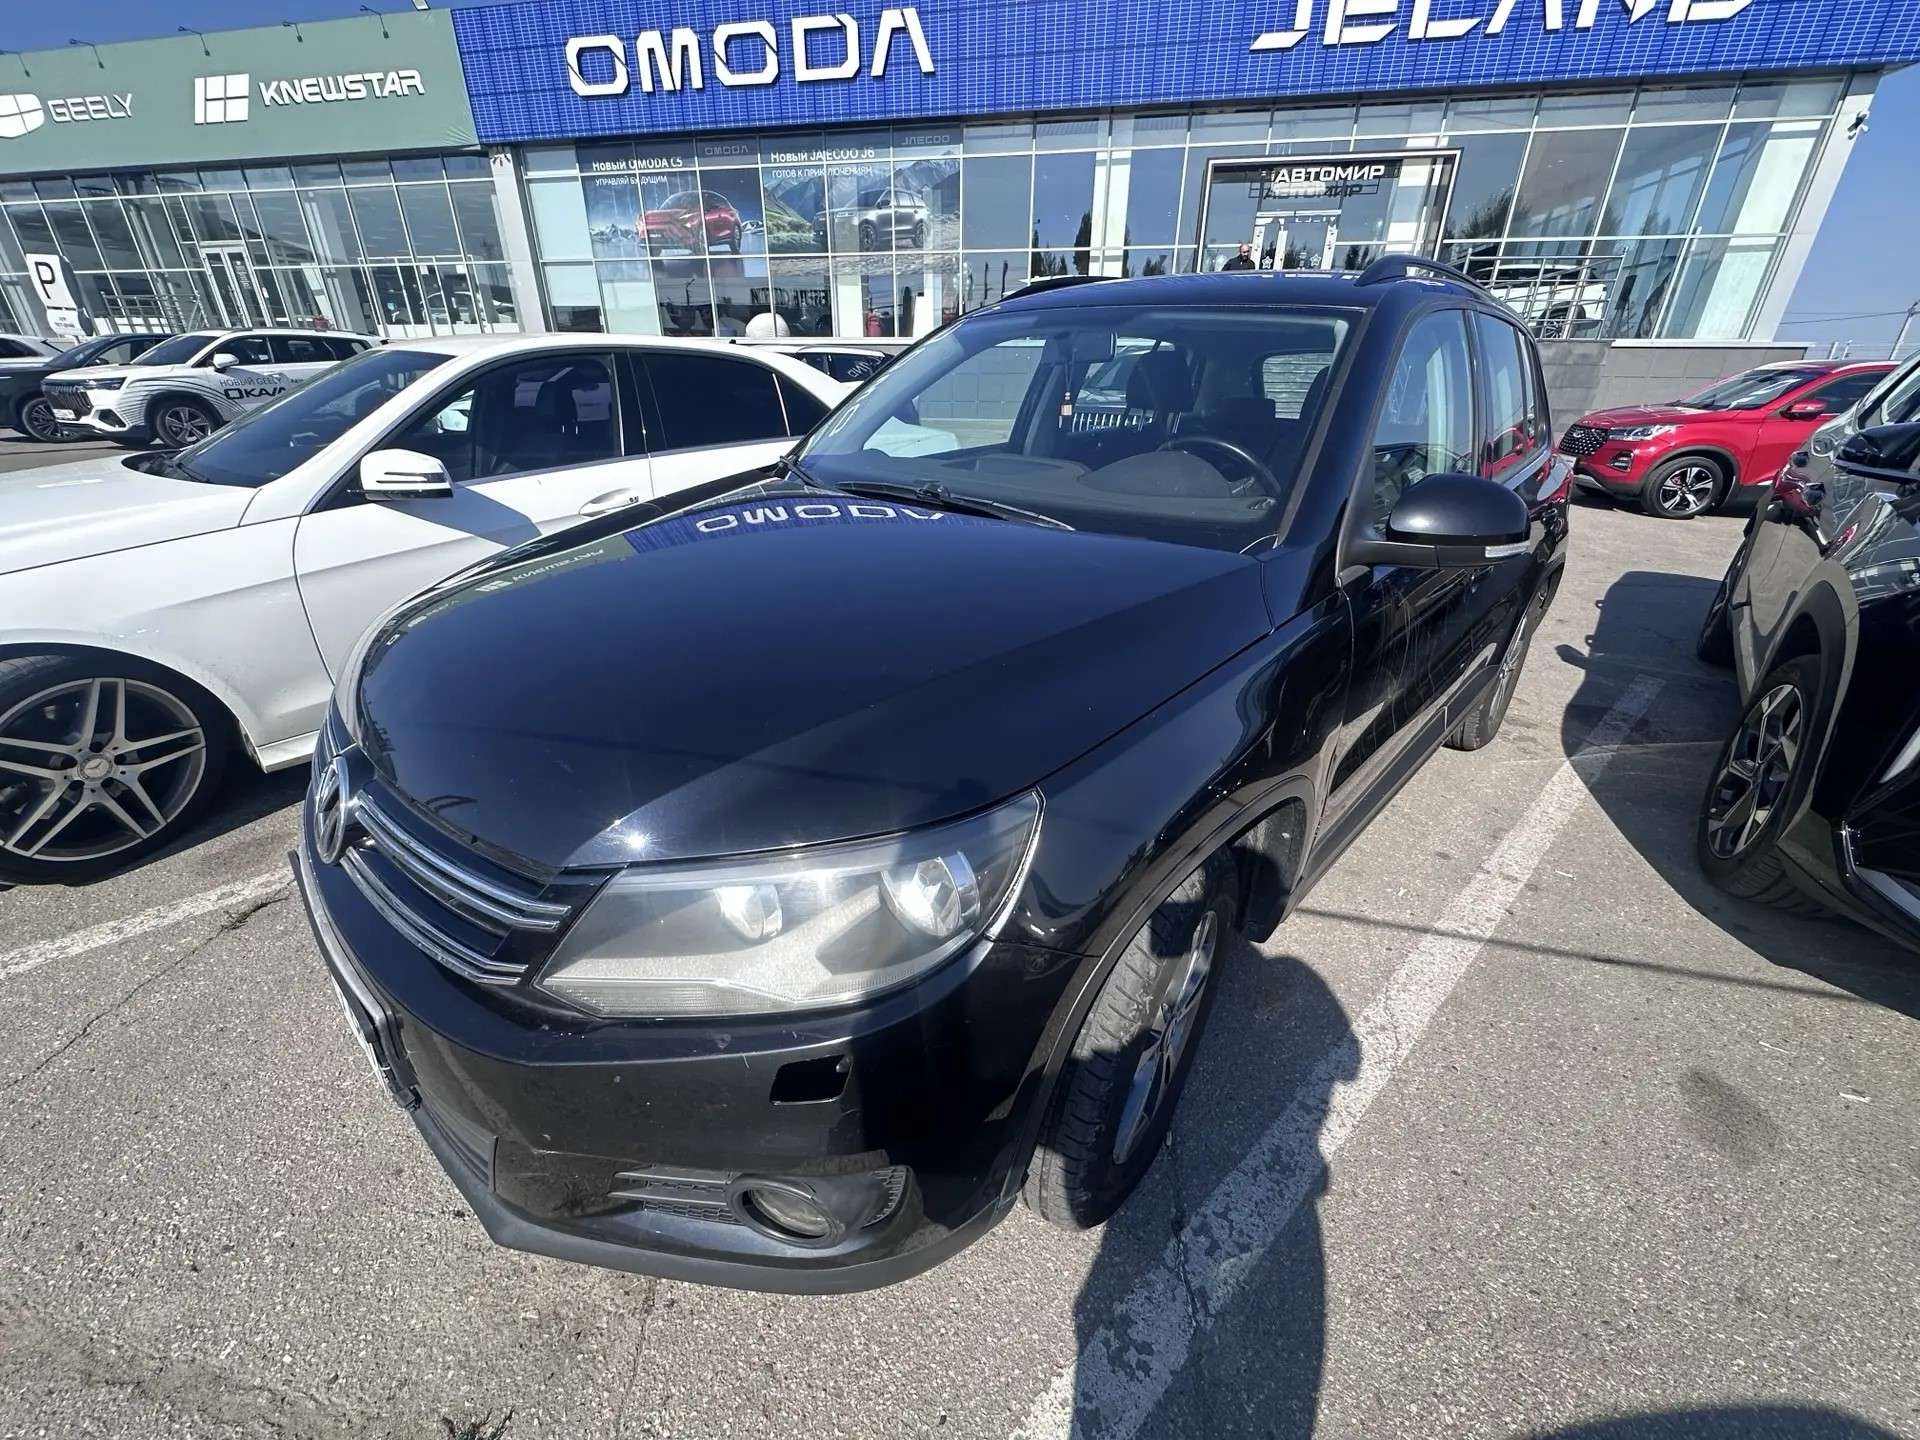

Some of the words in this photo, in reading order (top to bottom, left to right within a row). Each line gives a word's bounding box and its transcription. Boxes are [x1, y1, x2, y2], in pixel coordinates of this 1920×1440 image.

[565, 7, 935, 97] OMODA
[259, 69, 426, 107] KNEWSTAR
[47, 93, 133, 123] GEELY
[705, 145, 749, 156] OMODA
[902, 135, 950, 146] JAECOO
[810, 149, 859, 161] JAECOO
[1274, 165, 1386, 183] АВТОМИР
[34, 261, 56, 300] P
